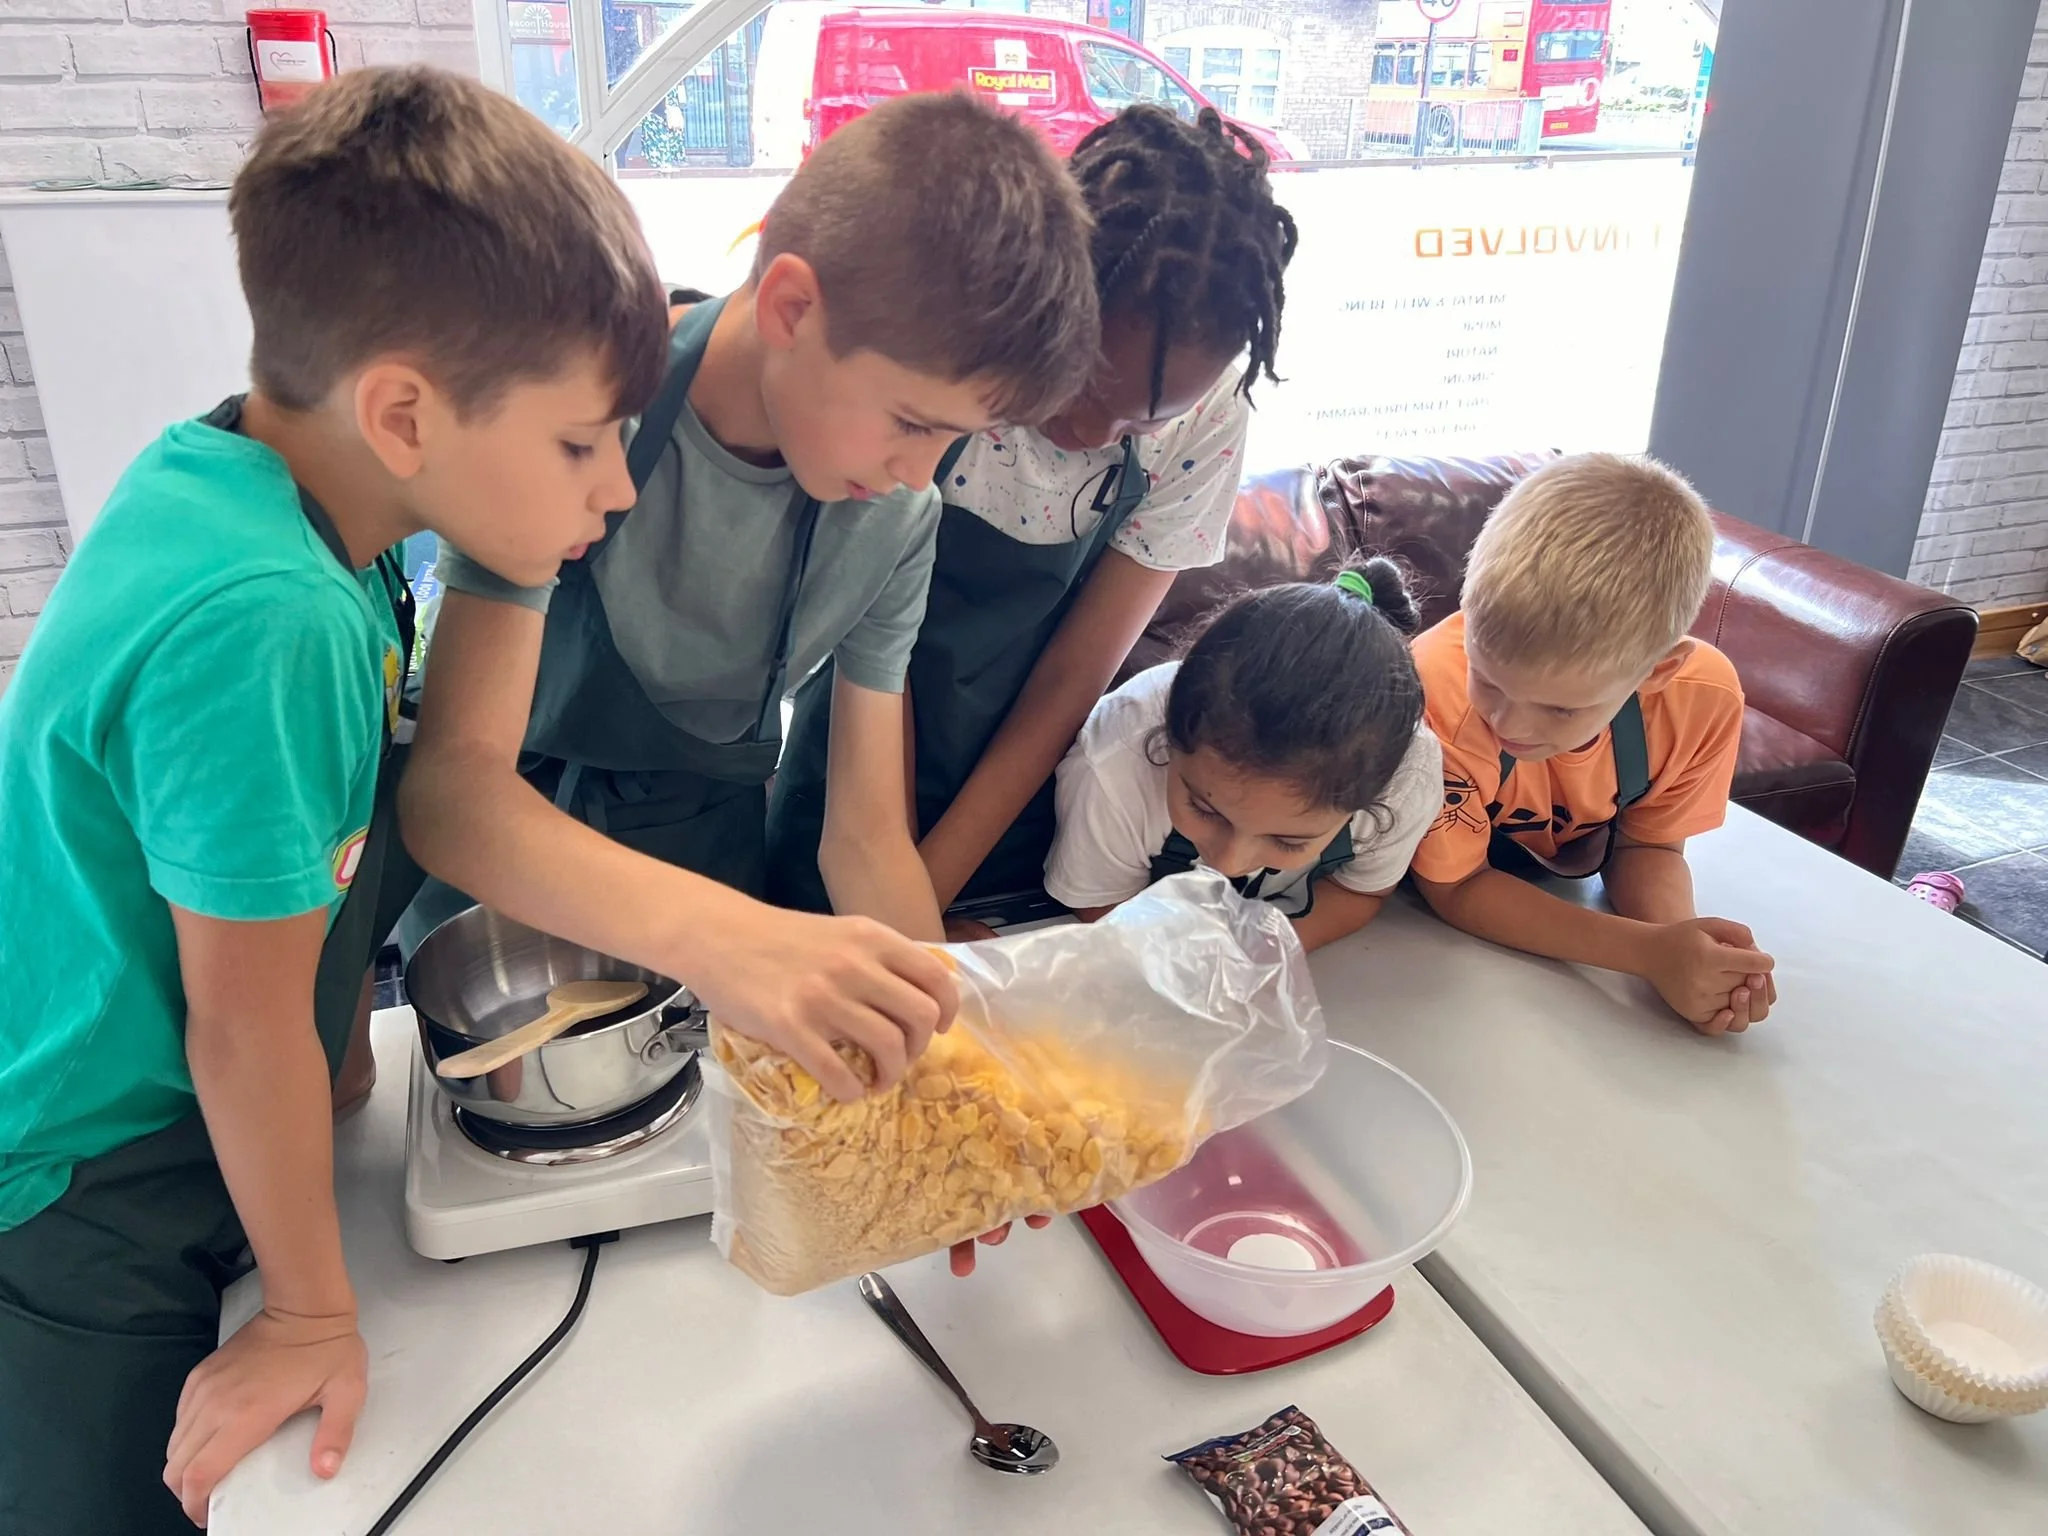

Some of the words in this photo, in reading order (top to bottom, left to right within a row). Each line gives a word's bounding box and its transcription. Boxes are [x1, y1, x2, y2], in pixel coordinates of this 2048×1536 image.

[508, 19, 537, 28] eacon
[975, 71, 1016, 91] Royal
[1018, 73, 1049, 90] Mail
